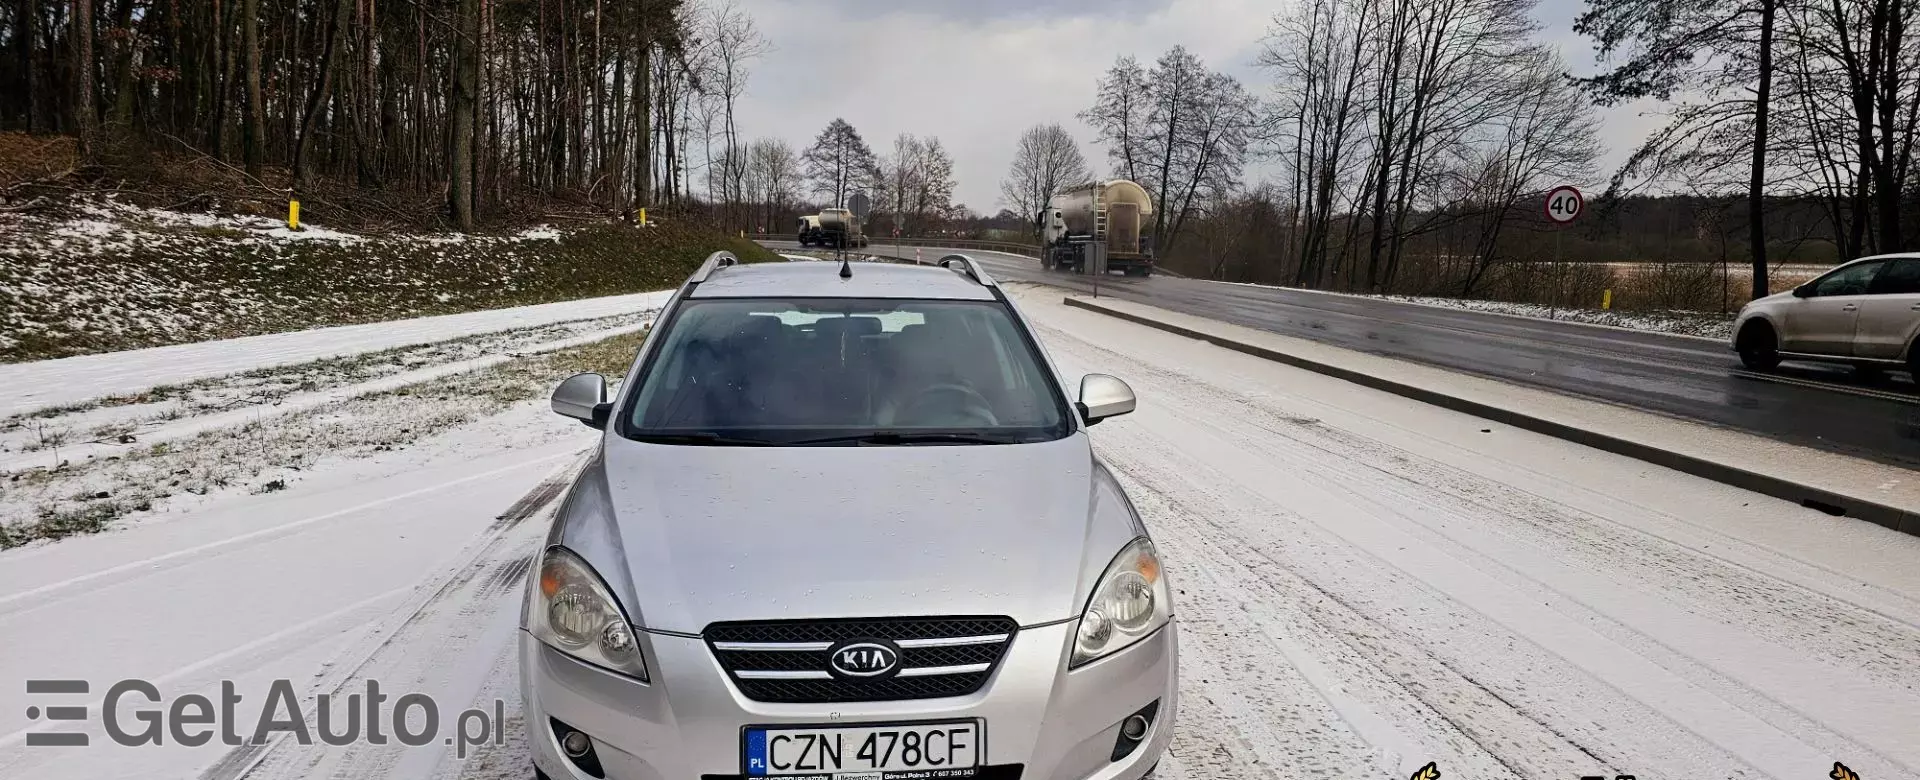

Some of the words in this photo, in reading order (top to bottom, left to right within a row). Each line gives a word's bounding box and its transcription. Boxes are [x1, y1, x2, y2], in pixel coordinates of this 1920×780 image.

[1550, 196, 1578, 215] 40
[842, 650, 886, 669] KIA
[769, 733, 842, 771] CZN
[856, 728, 970, 768] 478CF
[750, 758, 765, 769] PL
